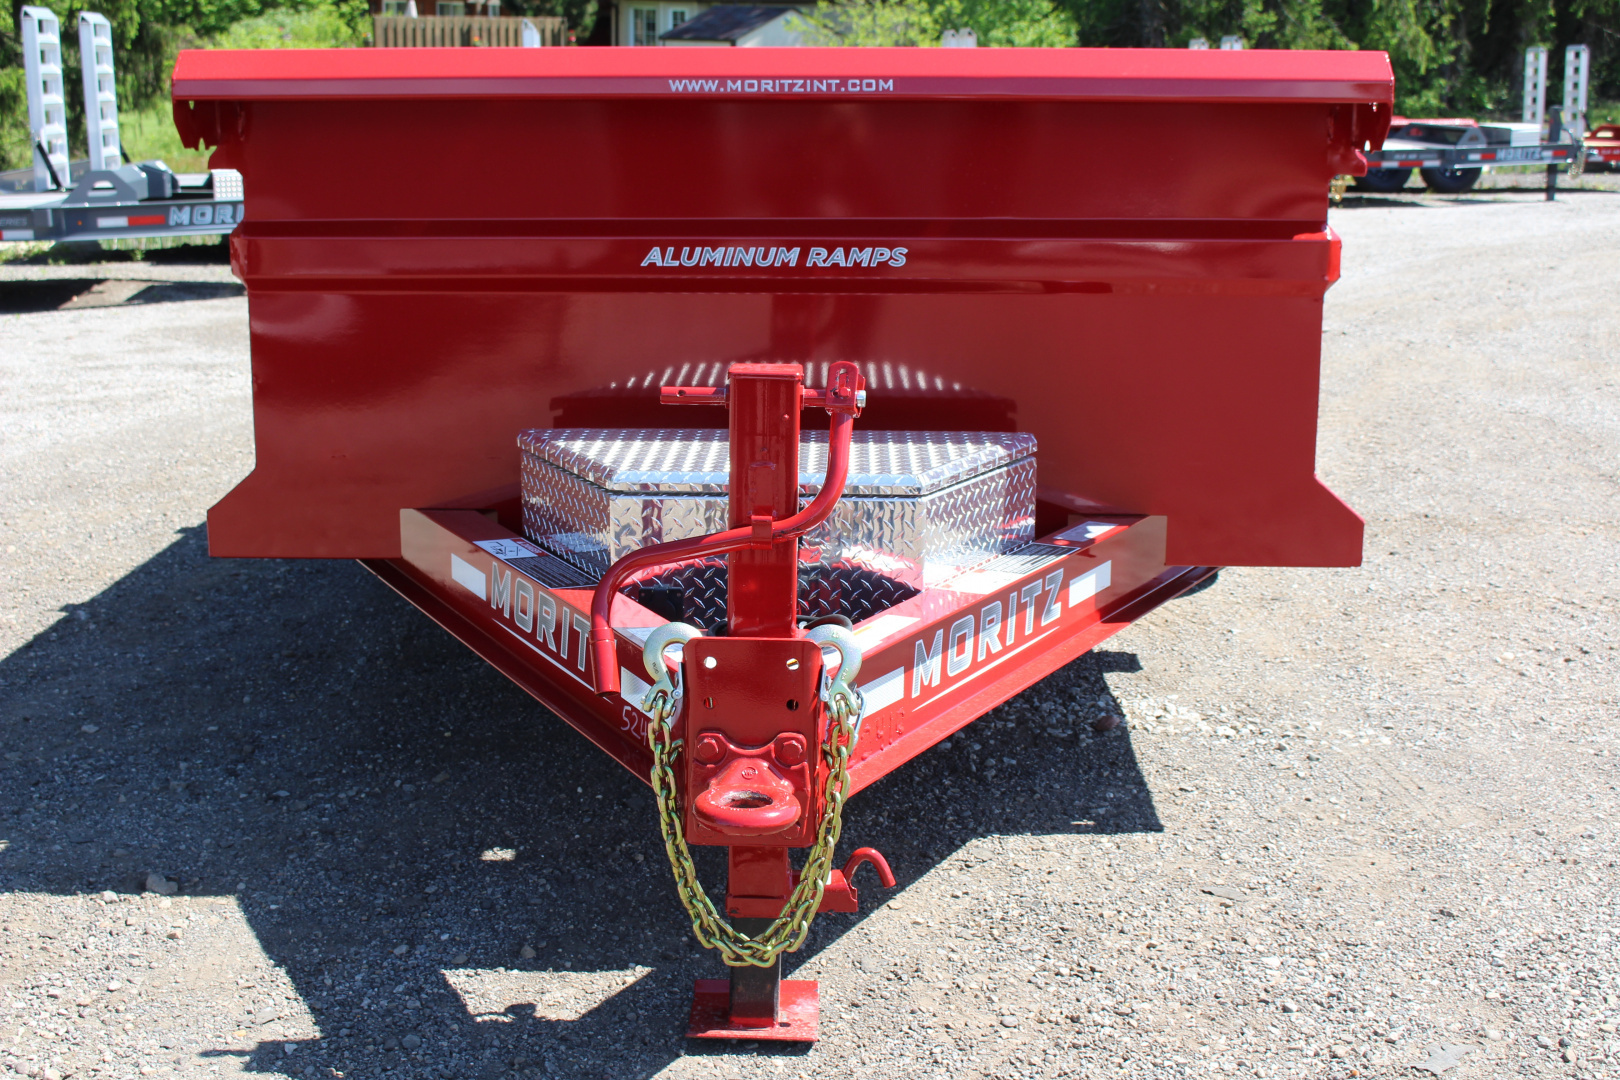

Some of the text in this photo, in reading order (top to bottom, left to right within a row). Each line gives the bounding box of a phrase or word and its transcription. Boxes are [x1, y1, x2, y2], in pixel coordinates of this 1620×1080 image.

[669, 79, 894, 92] WWW.MORITZINT.COM
[168, 203, 245, 226] MORI
[640, 246, 909, 268] ALUMINUM RAMPS
[490, 561, 616, 672] MORIT
[911, 567, 1064, 698] MORITZ
[620, 705, 650, 746] 524
